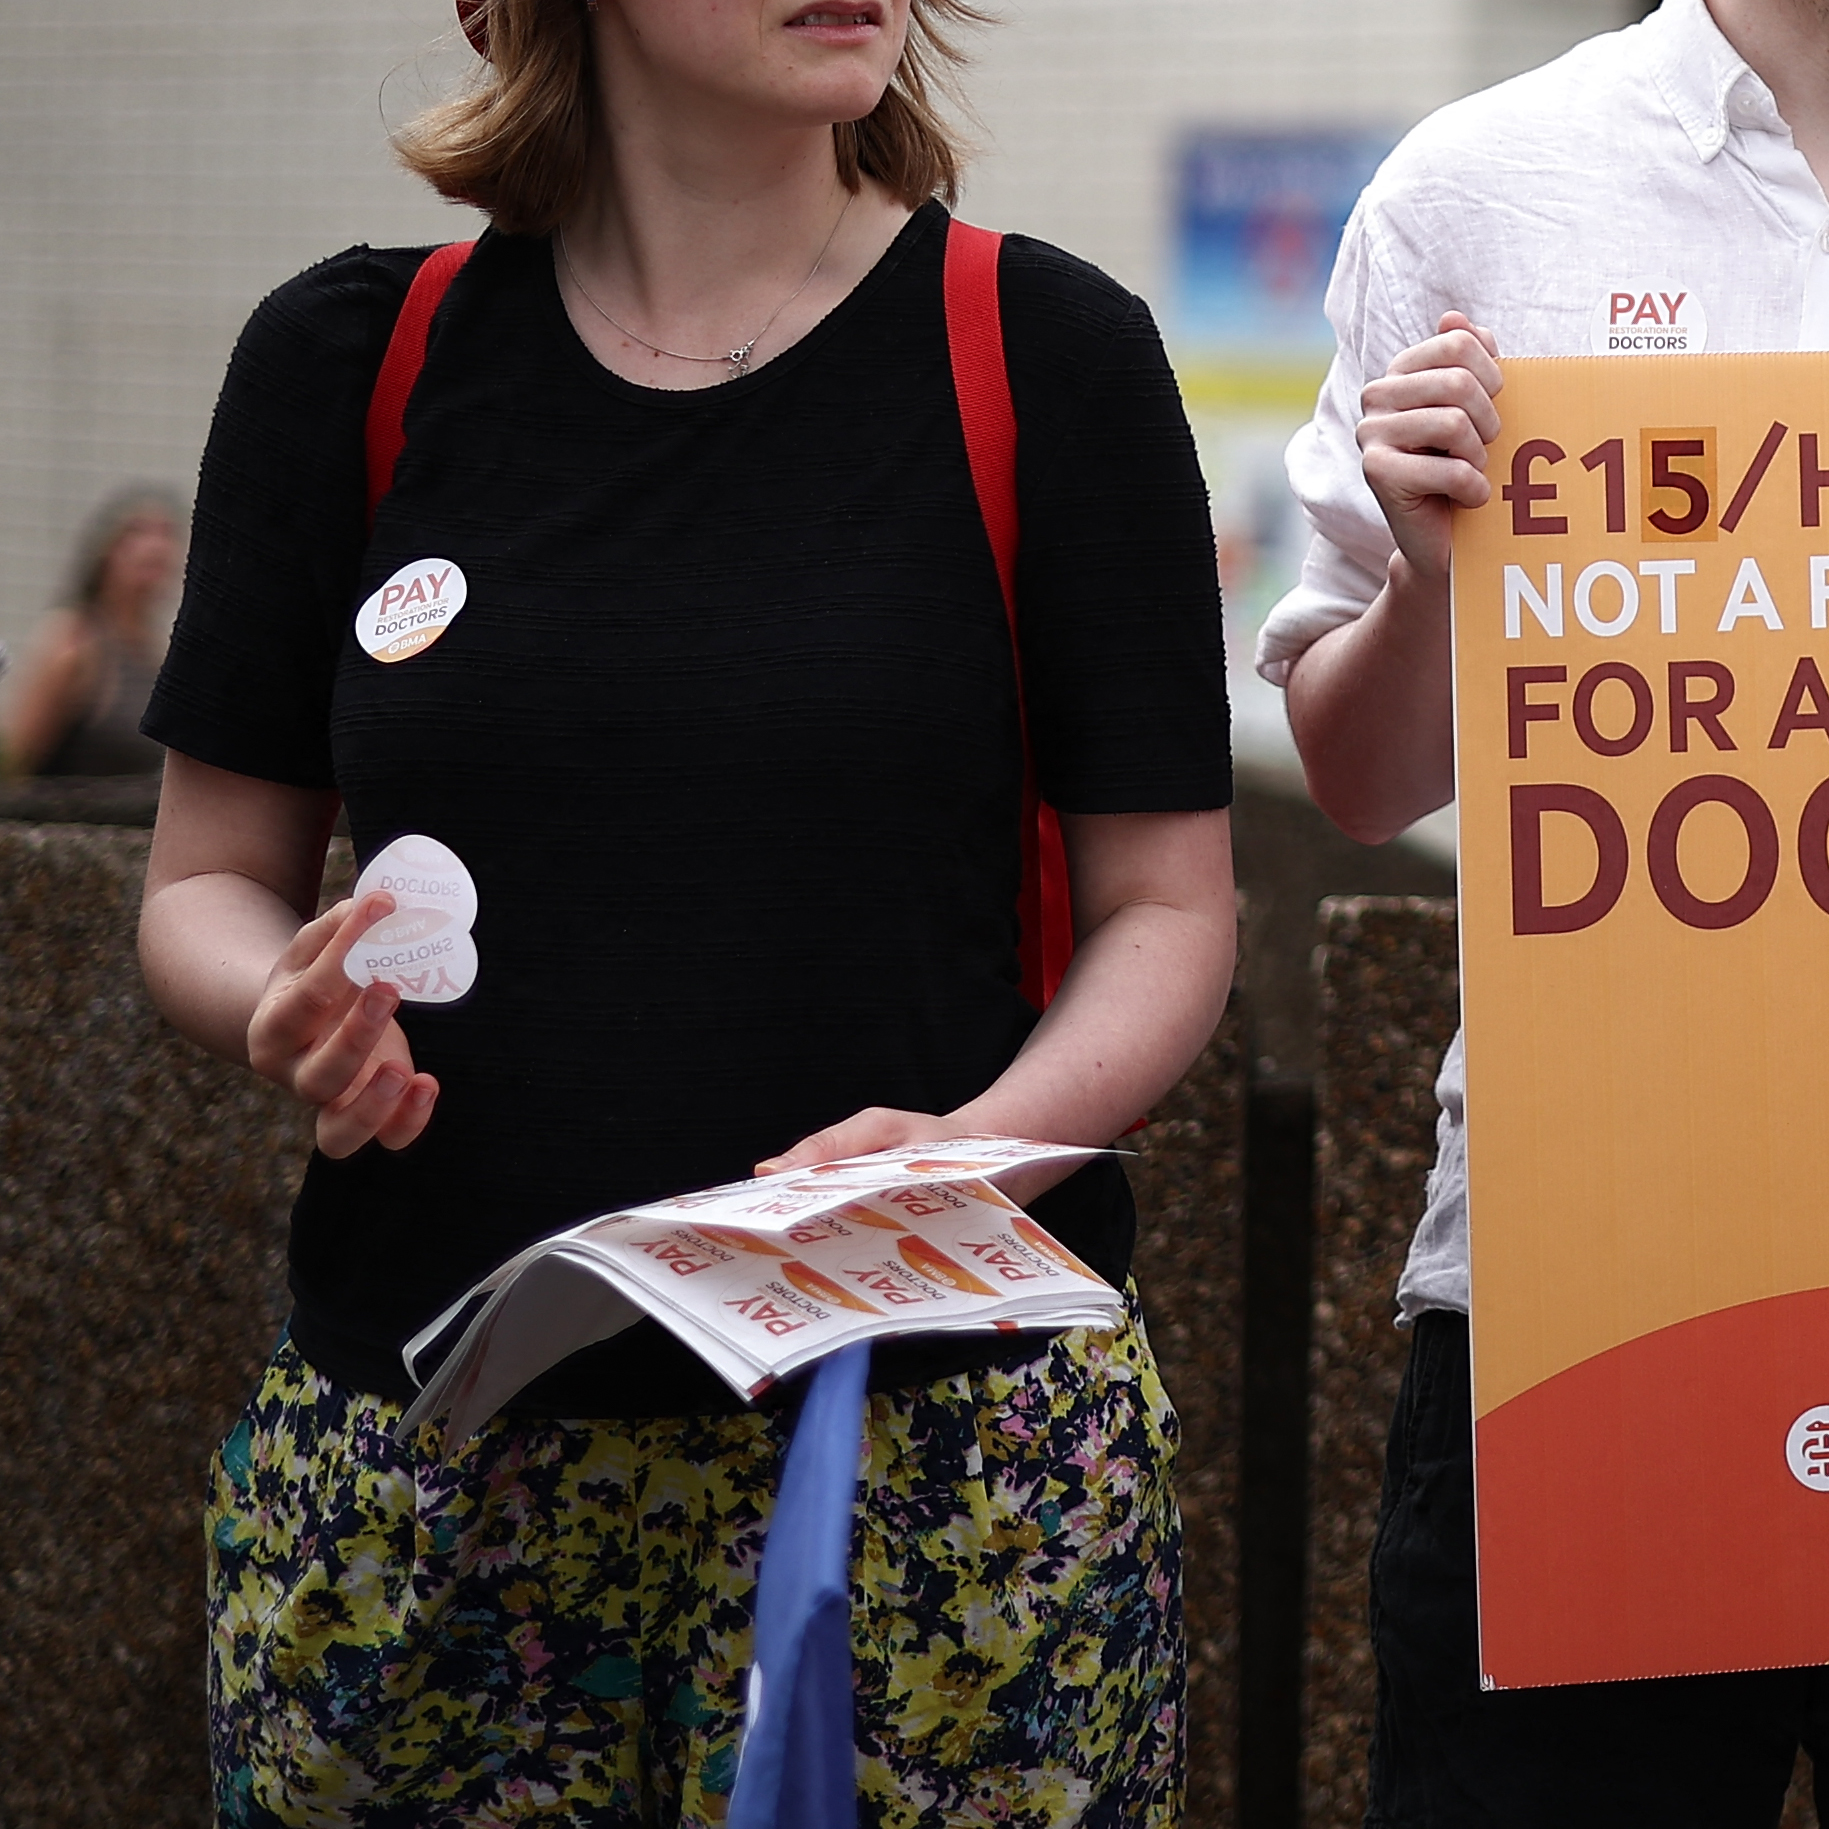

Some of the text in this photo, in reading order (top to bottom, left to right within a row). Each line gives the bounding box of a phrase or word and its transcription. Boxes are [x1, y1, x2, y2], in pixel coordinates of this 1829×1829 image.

[1610, 292, 1687, 325] PAY
[1609, 327, 1688, 335] RESTORATION FOR
[1609, 336, 1687, 349] DOCTORS
[379, 566, 452, 616] PAY
[1504, 560, 1695, 638] NOT
[1718, 558, 1783, 631] A
[375, 606, 447, 635] DOCTORS
[378, 603, 431, 623] RESTORATION
[401, 634, 427, 649] BMA
[1507, 660, 1738, 759] FOR
[629, 1239, 713, 1277] PAY
[671, 1230, 736, 1262] DOCTORS
[958, 1240, 1040, 1282] PAY
[997, 1233, 1061, 1277] DOCTORS
[842, 1269, 924, 1305] PAY
[883, 1260, 947, 1301] DOCTORS
[723, 1294, 808, 1337] PAY
[765, 1281, 831, 1320] DOCTORS
